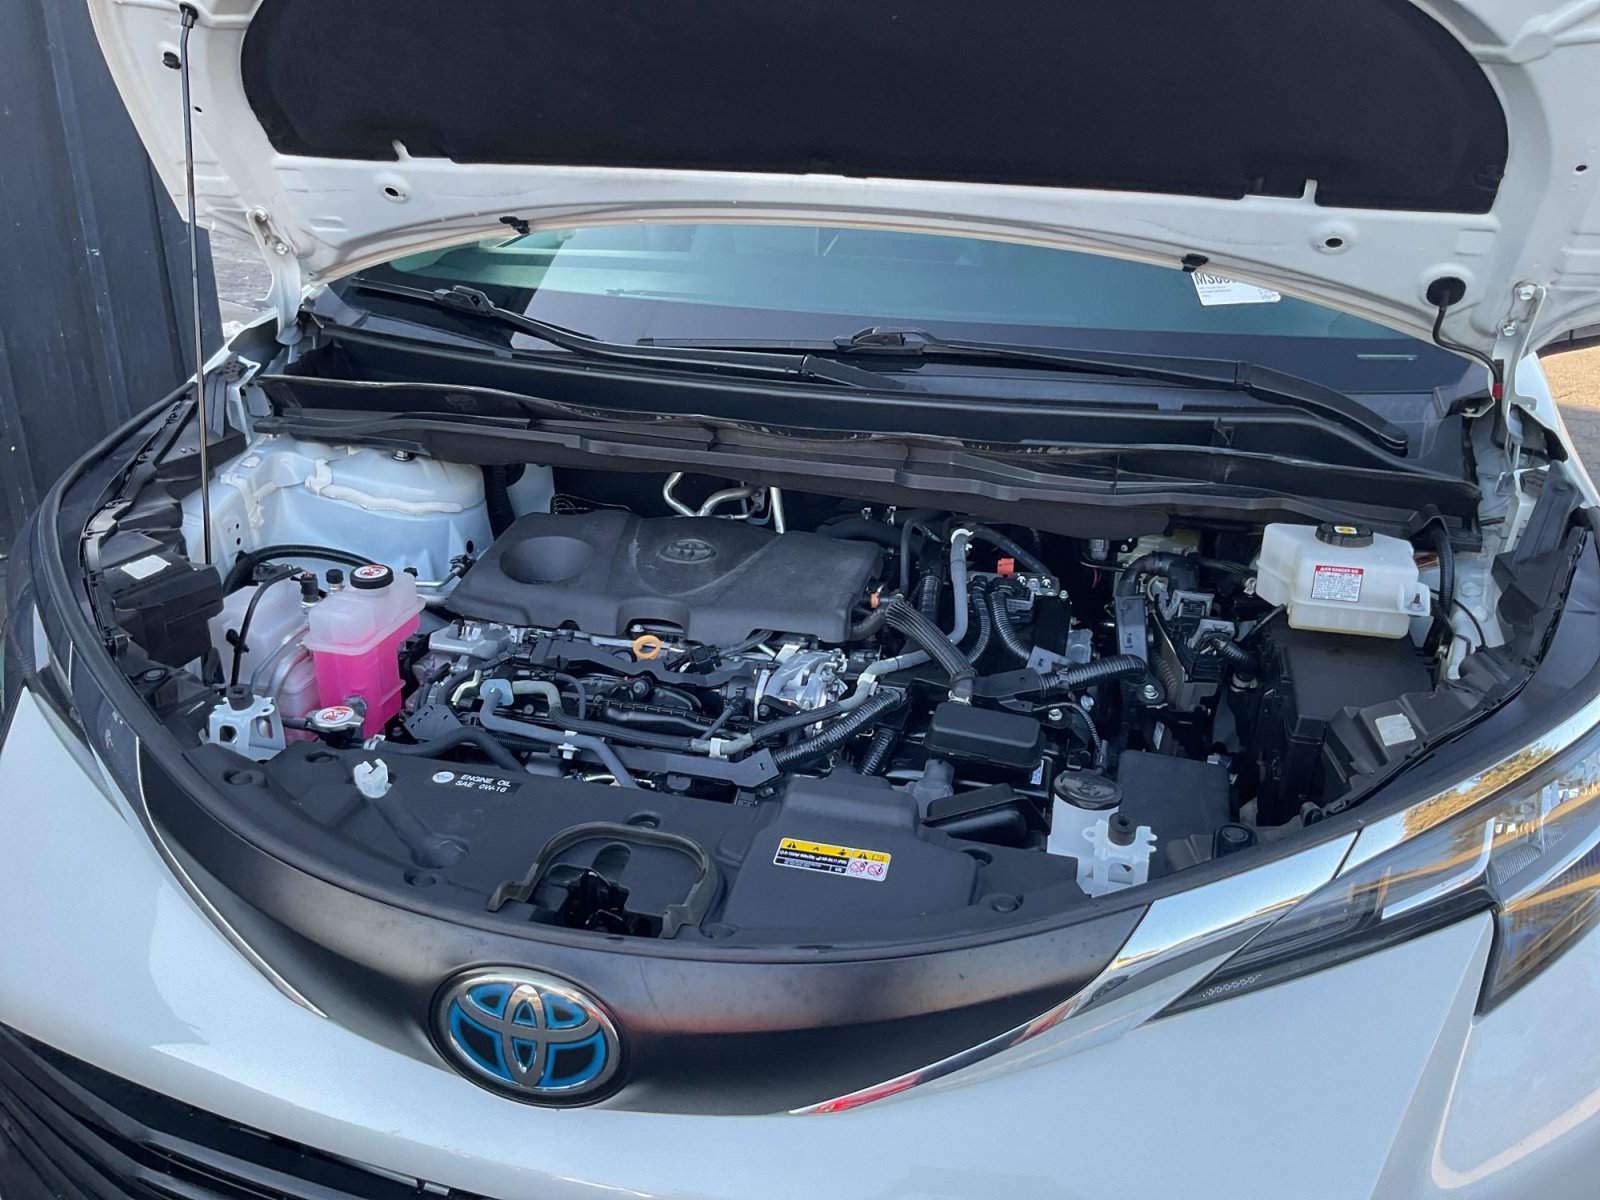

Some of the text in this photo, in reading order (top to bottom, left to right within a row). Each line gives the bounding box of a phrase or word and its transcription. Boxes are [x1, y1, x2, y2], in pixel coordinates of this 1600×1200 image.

[455, 780, 475, 788] SAE
[460, 774, 511, 788] ENGINE OIL
